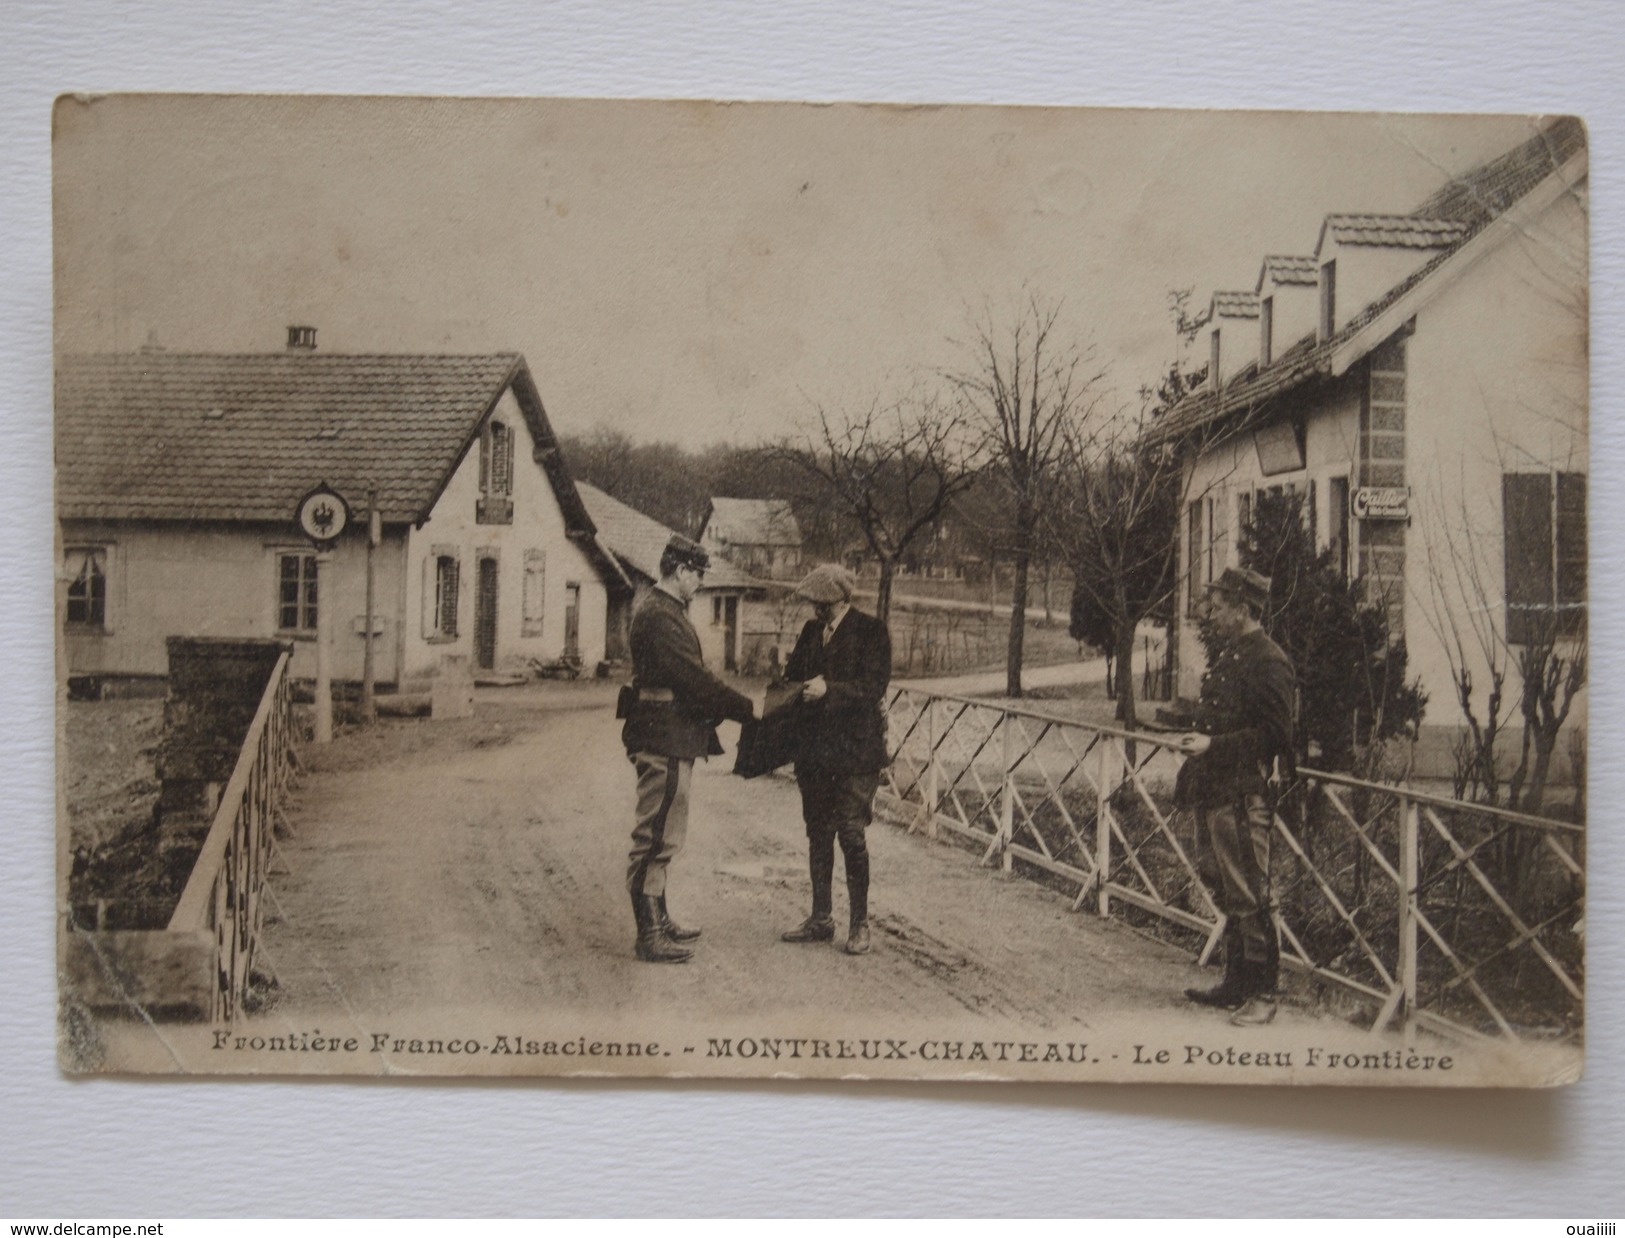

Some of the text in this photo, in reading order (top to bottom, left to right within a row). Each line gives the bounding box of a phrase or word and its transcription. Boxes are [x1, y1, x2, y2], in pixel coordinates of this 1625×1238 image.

[211, 1029, 359, 1053] Frontière
[369, 1032, 672, 1058] Franco-Alsacienne.
[706, 1037, 1100, 1063] MONTREUX-CHATEAU.
[1132, 1044, 1171, 1065] Le
[1183, 1046, 1293, 1068] Poteau
[1305, 1047, 1454, 1071] Frontière
